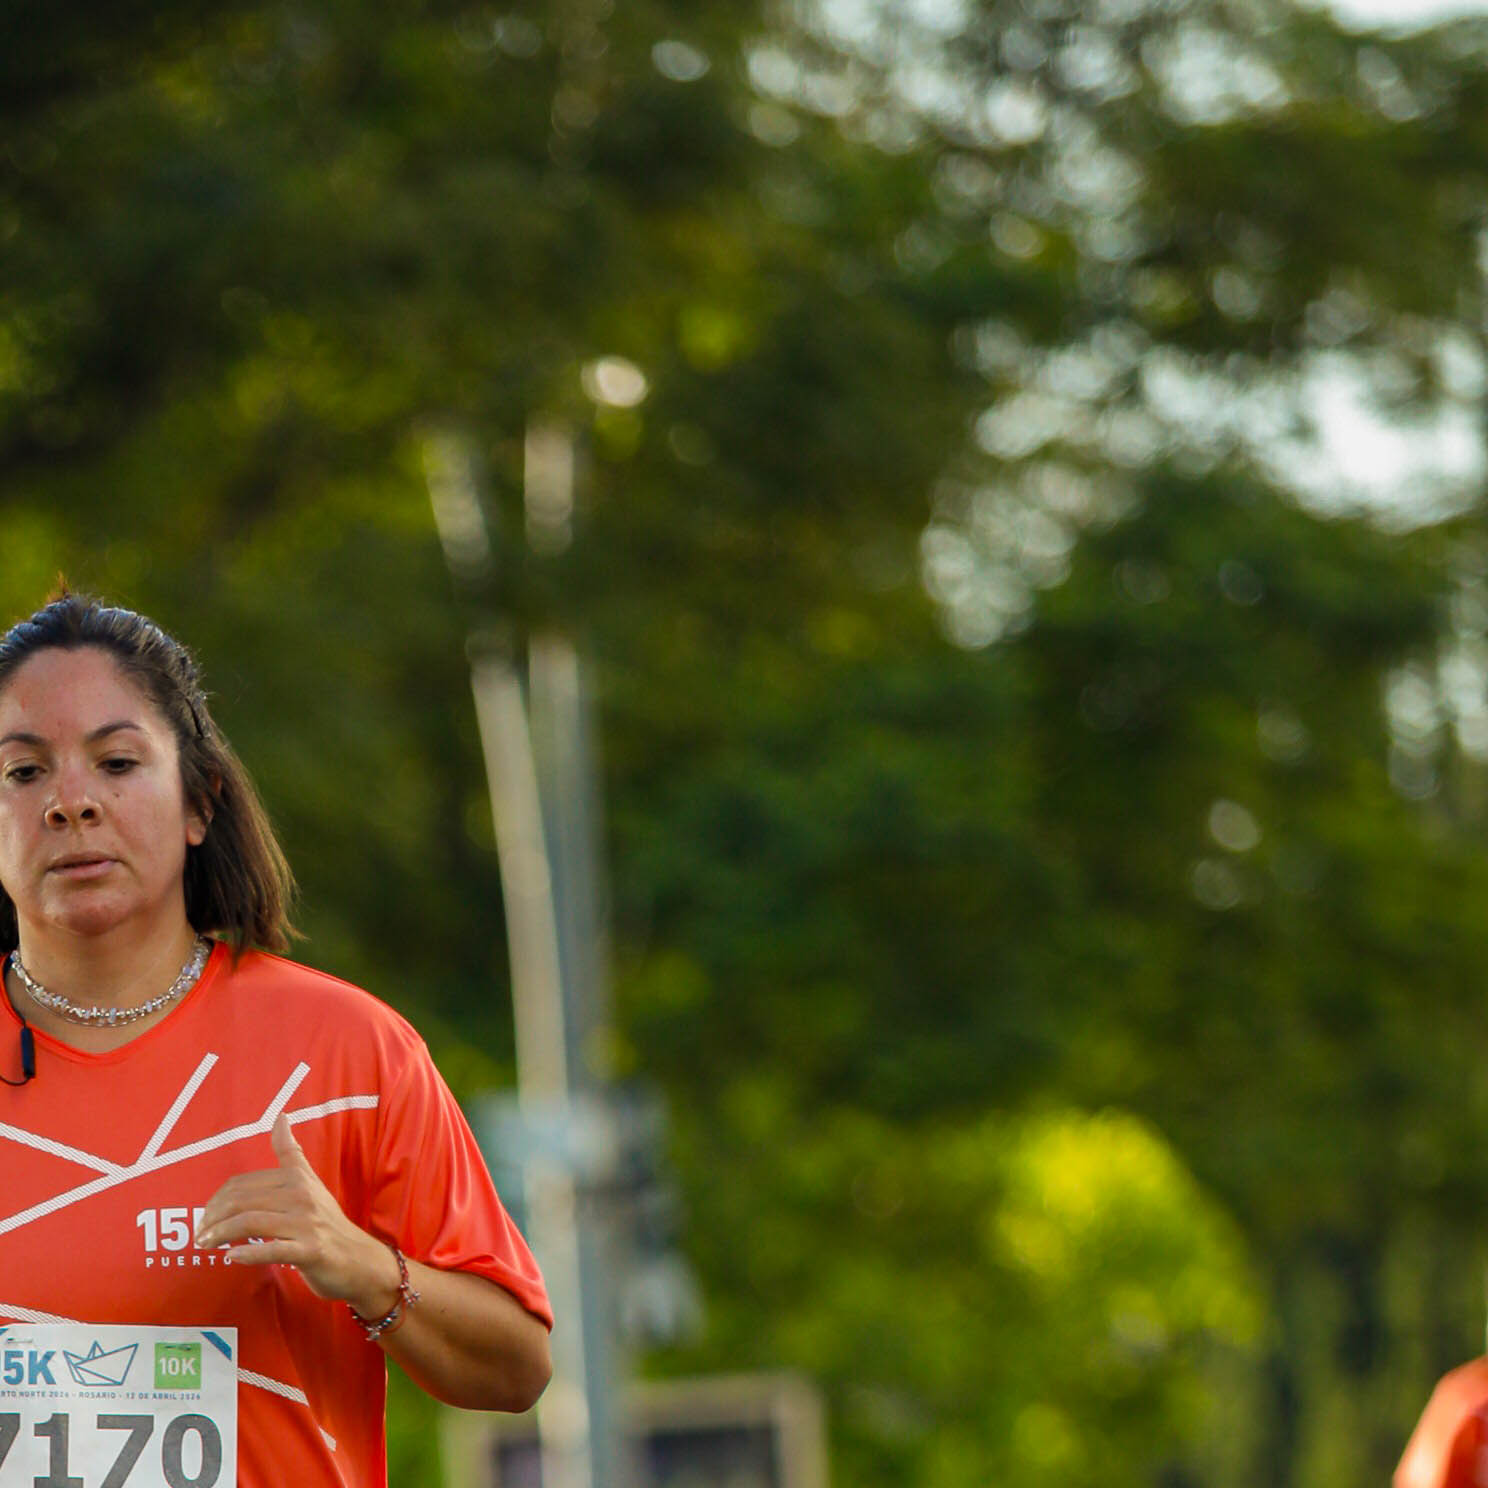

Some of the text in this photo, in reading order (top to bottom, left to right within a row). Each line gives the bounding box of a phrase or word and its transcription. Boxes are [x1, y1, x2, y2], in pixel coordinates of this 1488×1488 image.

[146, 1255, 232, 1268] PUERTO
[159, 1357, 196, 1376] 10K
[19, 1390, 46, 1398] NORTE
[79, 1391, 116, 1399] ROSARIO
[138, 1392, 149, 1400] DE
[152, 1392, 177, 1400] ABRIL
